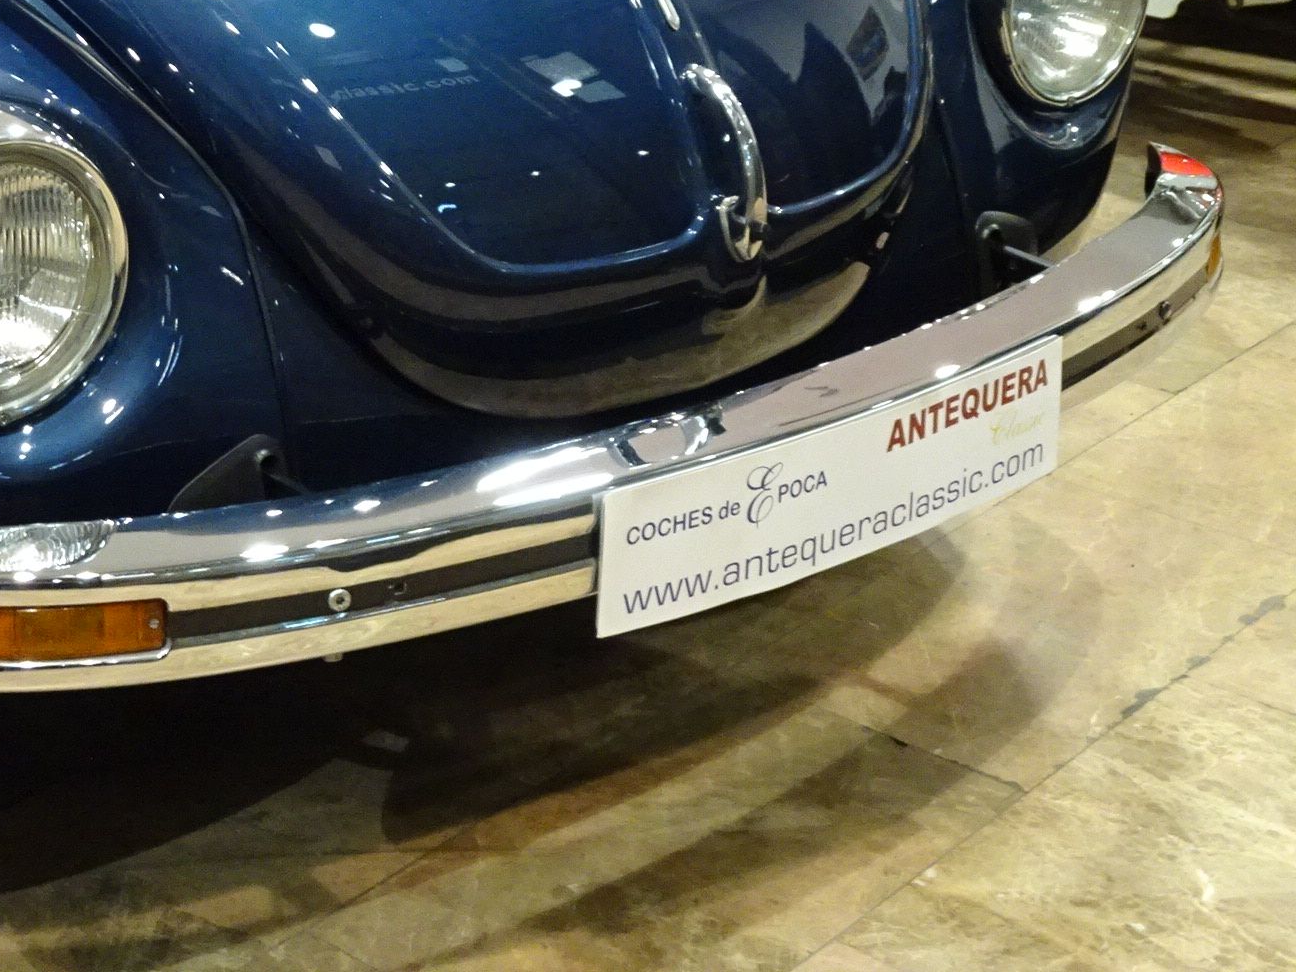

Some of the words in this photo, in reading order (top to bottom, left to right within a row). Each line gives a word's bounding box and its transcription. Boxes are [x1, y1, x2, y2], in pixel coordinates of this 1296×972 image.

[886, 359, 1048, 453] ANTEQUERA
[623, 442, 1044, 615] www.antequeraclassic.com
[626, 506, 713, 546] COCHES
[718, 500, 740, 520] de
